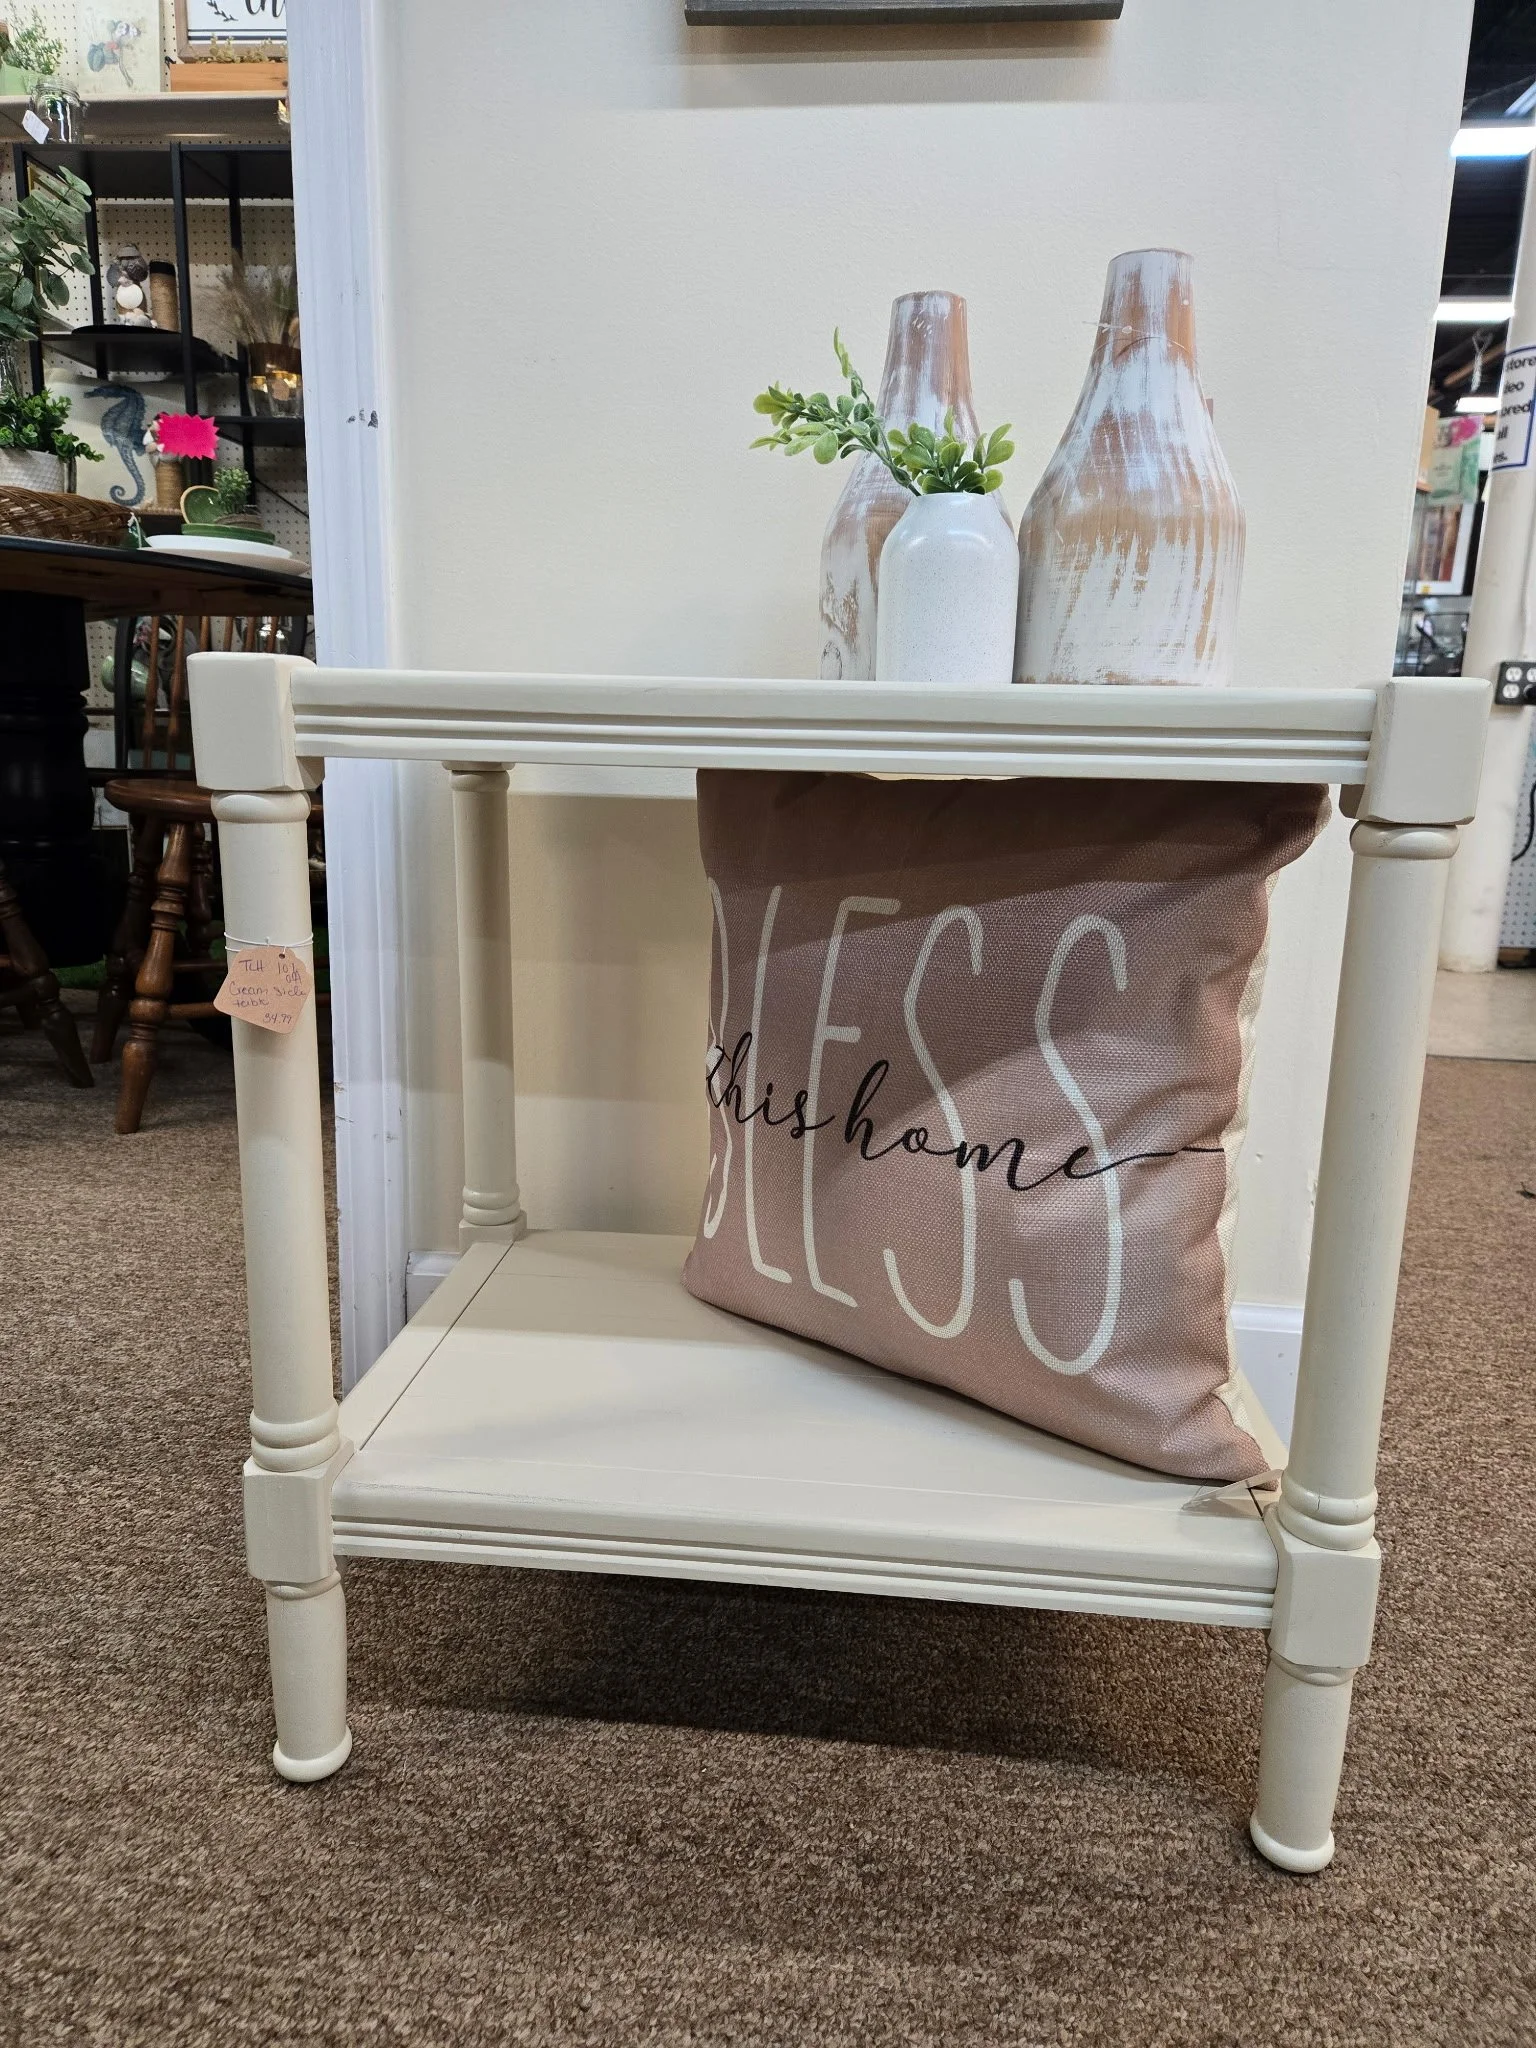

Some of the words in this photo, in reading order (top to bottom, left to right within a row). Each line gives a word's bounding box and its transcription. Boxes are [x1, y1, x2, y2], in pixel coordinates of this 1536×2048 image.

[229, 981, 269, 997] Cream
[703, 877, 1129, 1377] BLESS
[706, 1032, 834, 1140] this
[844, 1060, 1225, 1191] home
